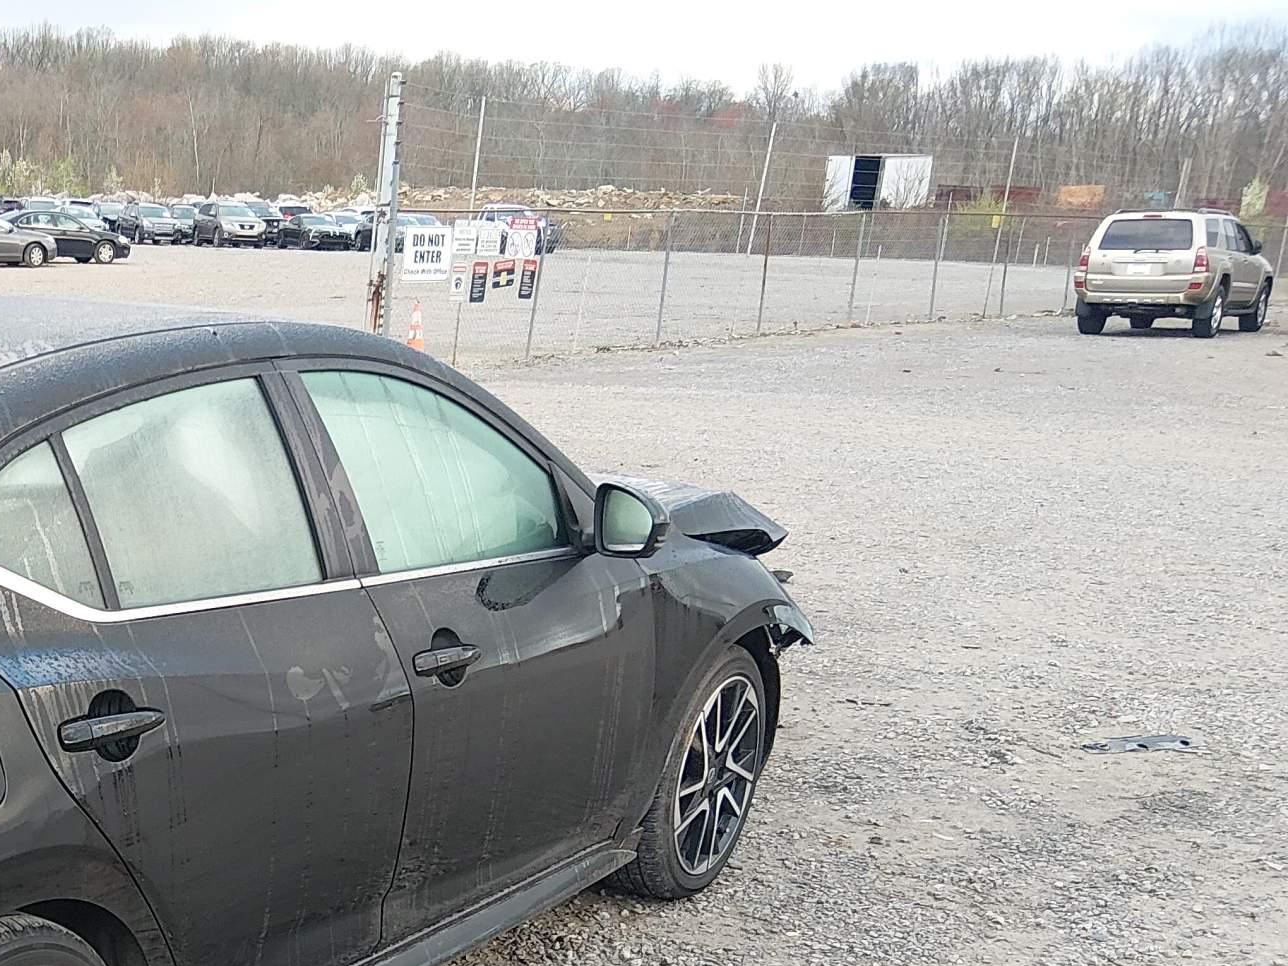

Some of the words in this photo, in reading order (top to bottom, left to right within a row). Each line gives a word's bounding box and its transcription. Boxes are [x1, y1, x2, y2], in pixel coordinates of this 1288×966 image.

[412, 234, 425, 247] DO
[428, 233, 445, 247] NOT
[414, 250, 442, 264] ENTER
